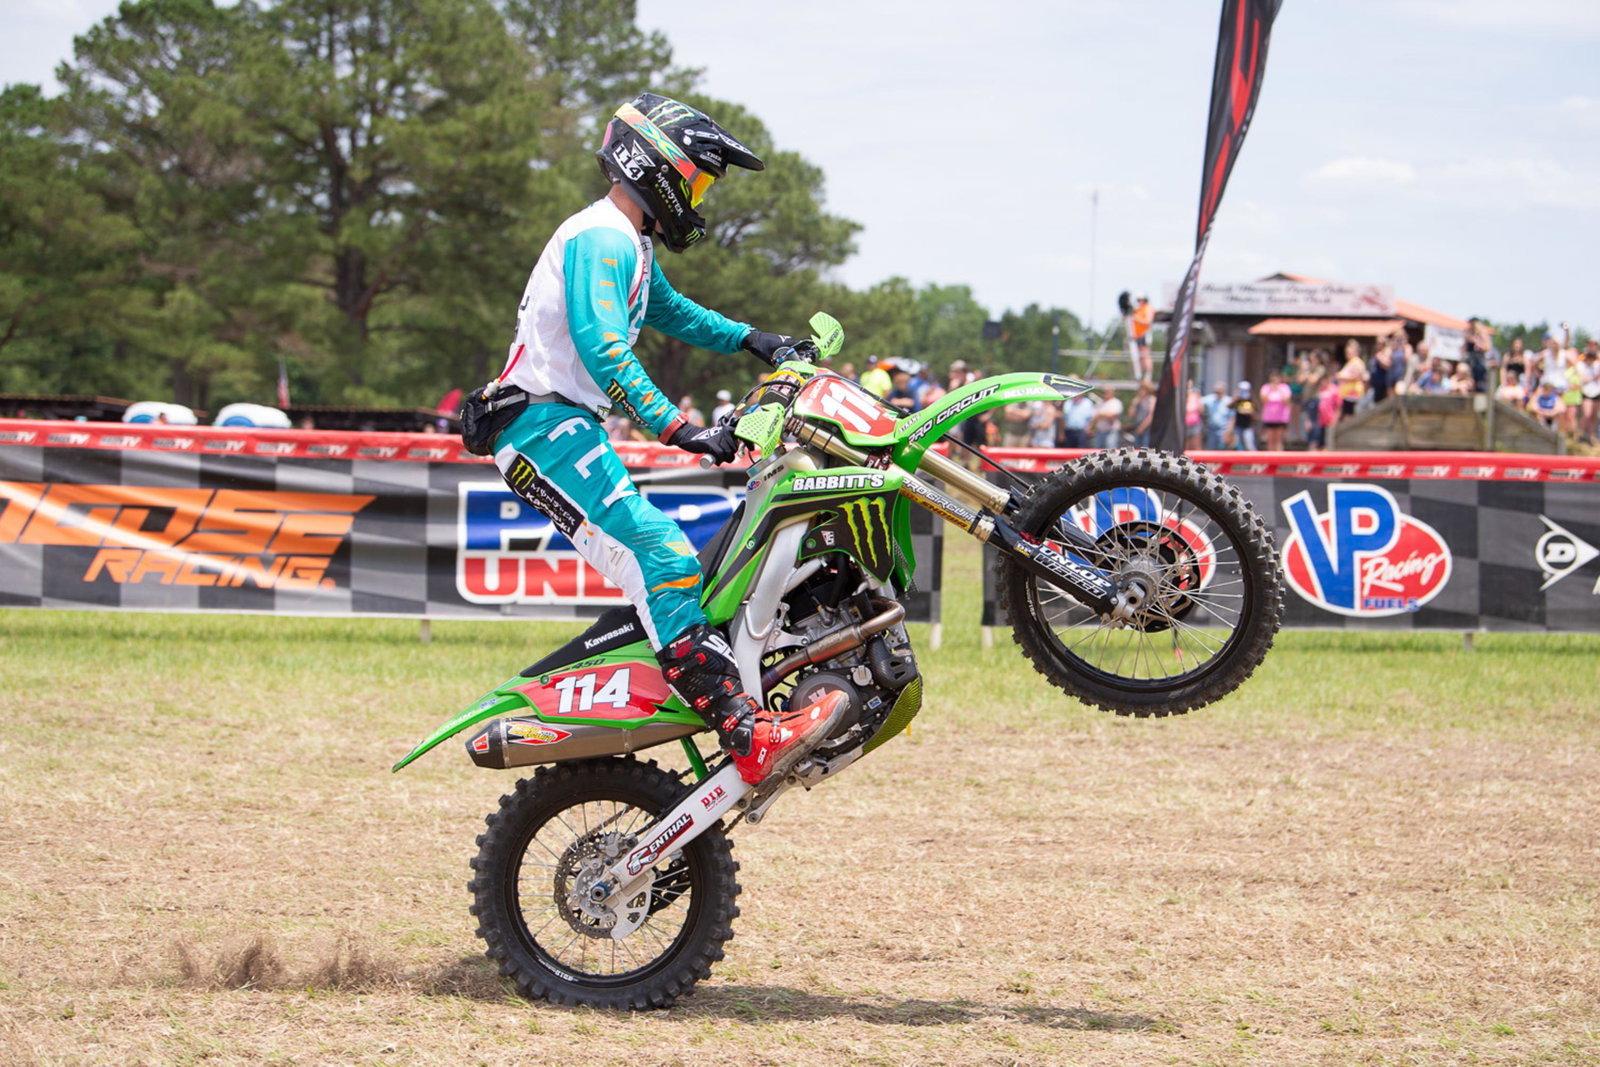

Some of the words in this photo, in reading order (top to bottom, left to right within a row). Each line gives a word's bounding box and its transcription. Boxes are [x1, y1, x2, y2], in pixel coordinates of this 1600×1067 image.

[612, 144, 642, 178] 114
[936, 384, 1000, 426] CIRCUIT
[763, 464, 784, 481] IMS
[793, 473, 884, 491] BABBITT'S
[525, 491, 571, 533] Kawasaki
[530, 482, 576, 526] MONSTER
[926, 490, 976, 523] CIRCUIT
[83, 548, 332, 590] RACING
[1289, 489, 1396, 610] VP
[1362, 551, 1446, 597] Racing
[1363, 597, 1421, 612] FUELS
[584, 622, 634, 650] Kawasaki
[554, 667, 631, 714] 114
[627, 812, 692, 875] RENTHAL
